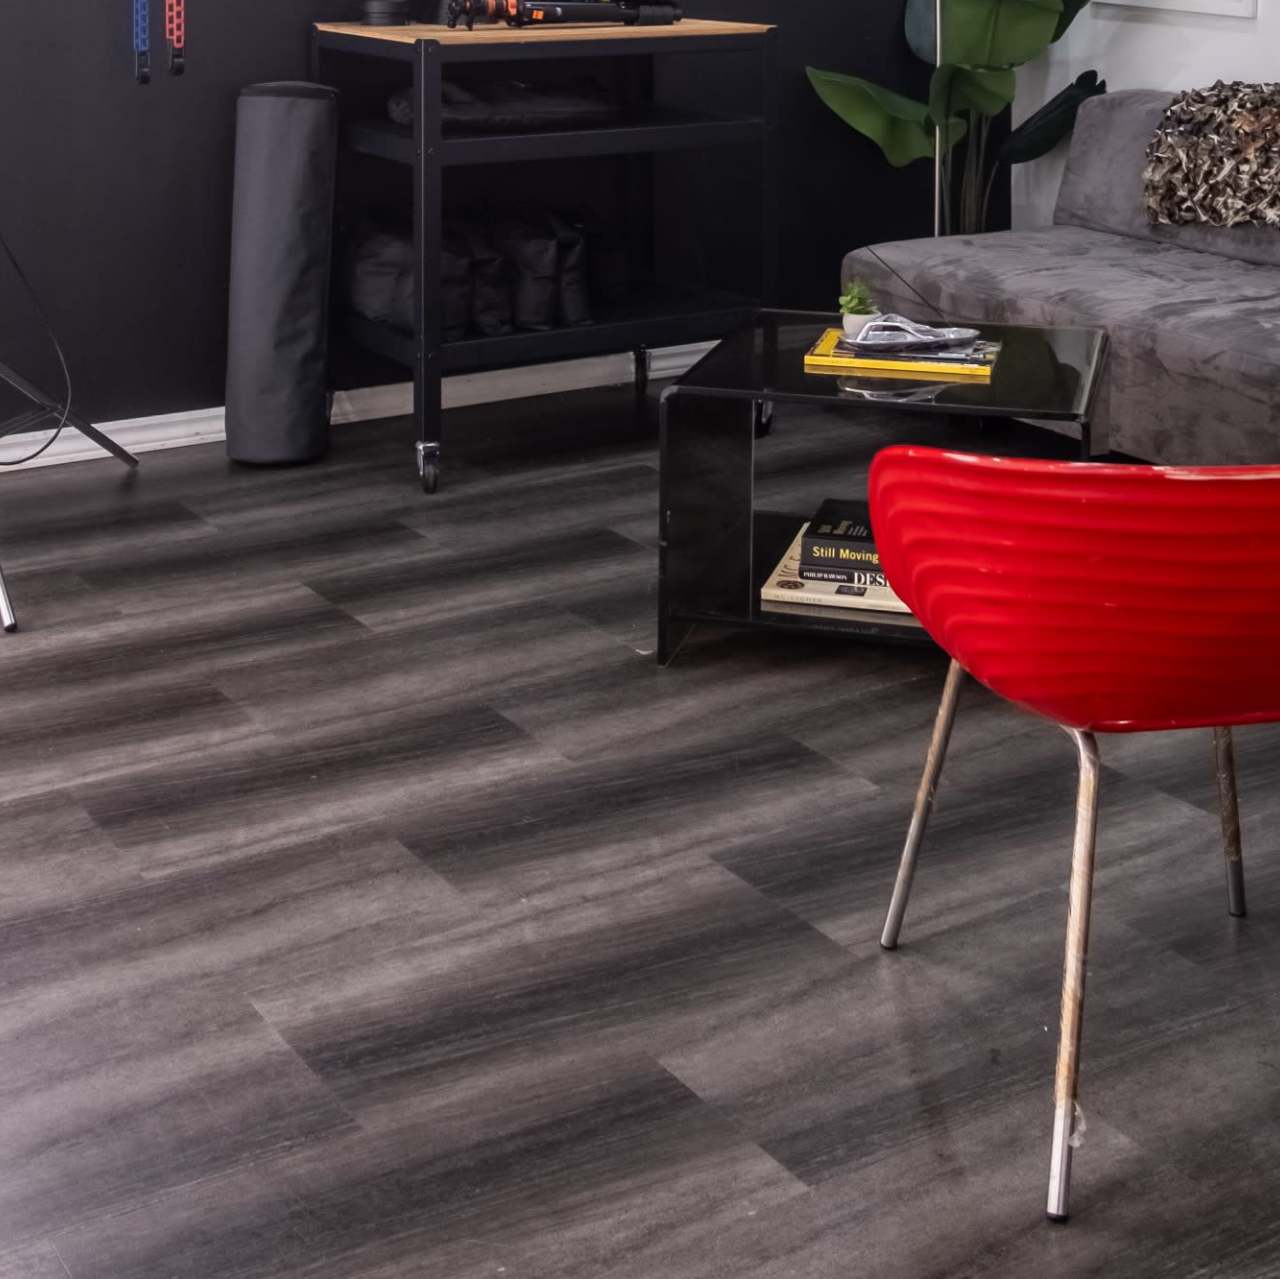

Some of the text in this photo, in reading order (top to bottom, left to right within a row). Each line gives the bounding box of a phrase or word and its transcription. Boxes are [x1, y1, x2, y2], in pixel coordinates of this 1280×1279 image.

[812, 545, 879, 564] Still Moving
[854, 572, 889, 587] DES
